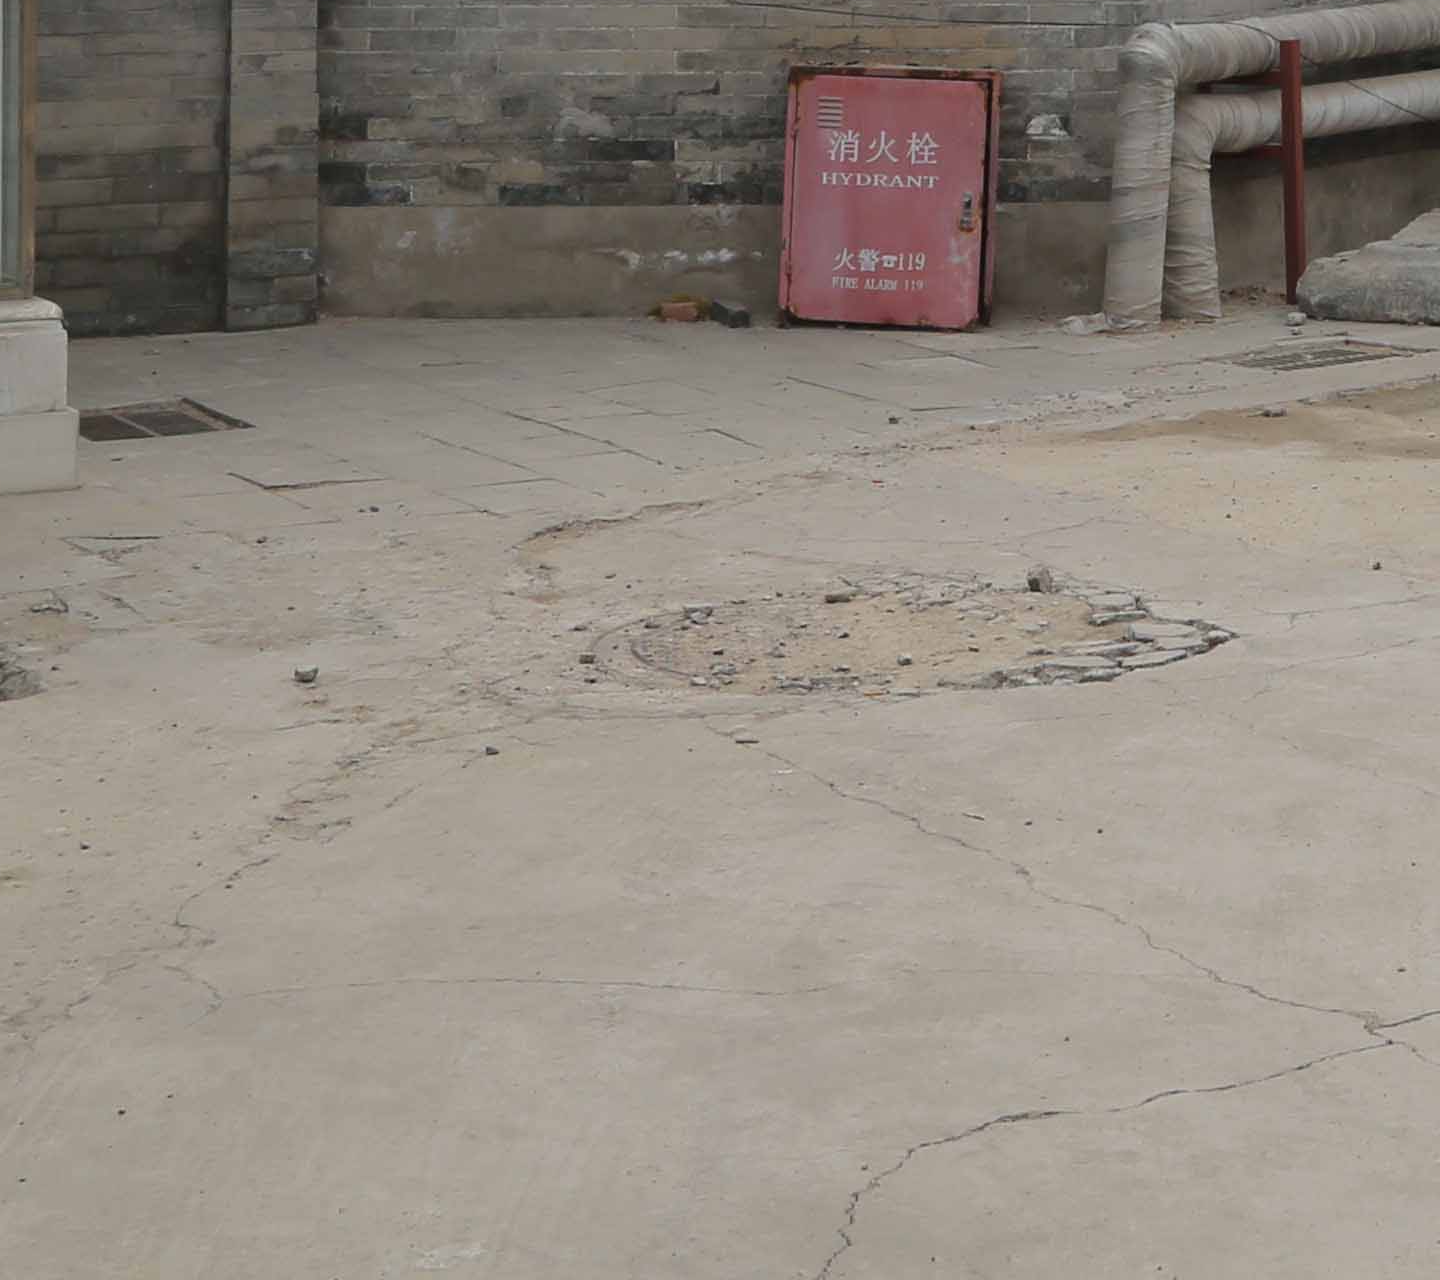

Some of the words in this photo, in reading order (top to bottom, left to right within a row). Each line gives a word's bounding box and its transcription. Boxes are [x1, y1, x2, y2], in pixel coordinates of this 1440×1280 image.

[828, 130, 941, 165] 消火栓
[820, 171, 940, 189] HYDRANT
[831, 276, 858, 289] FIRE
[863, 278, 898, 291] ALARM
